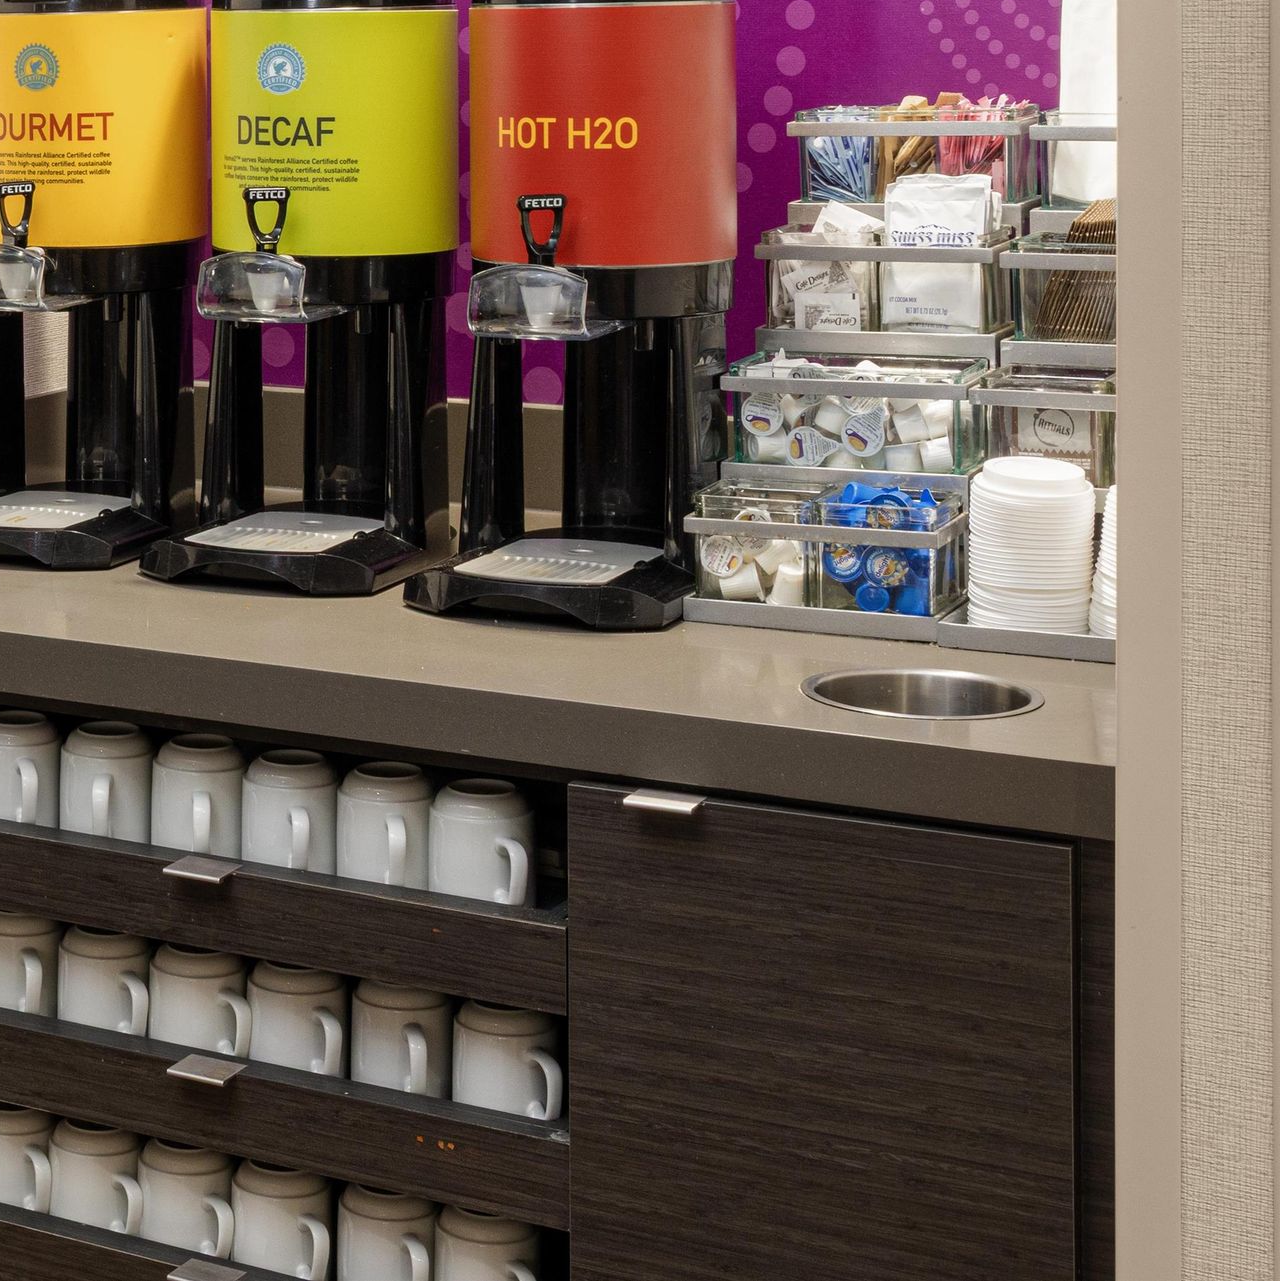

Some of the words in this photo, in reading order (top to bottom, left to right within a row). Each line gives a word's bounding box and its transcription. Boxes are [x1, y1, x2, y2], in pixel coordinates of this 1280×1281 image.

[238, 116, 335, 146] DECAF
[498, 116, 556, 149] HOT
[568, 117, 638, 149] H2O
[2, 184, 32, 194] FETCO
[249, 190, 286, 199] FETCO
[525, 198, 562, 208] FETCO
[1038, 418, 1070, 436] RITUALS
[875, 554, 892, 577] delight
